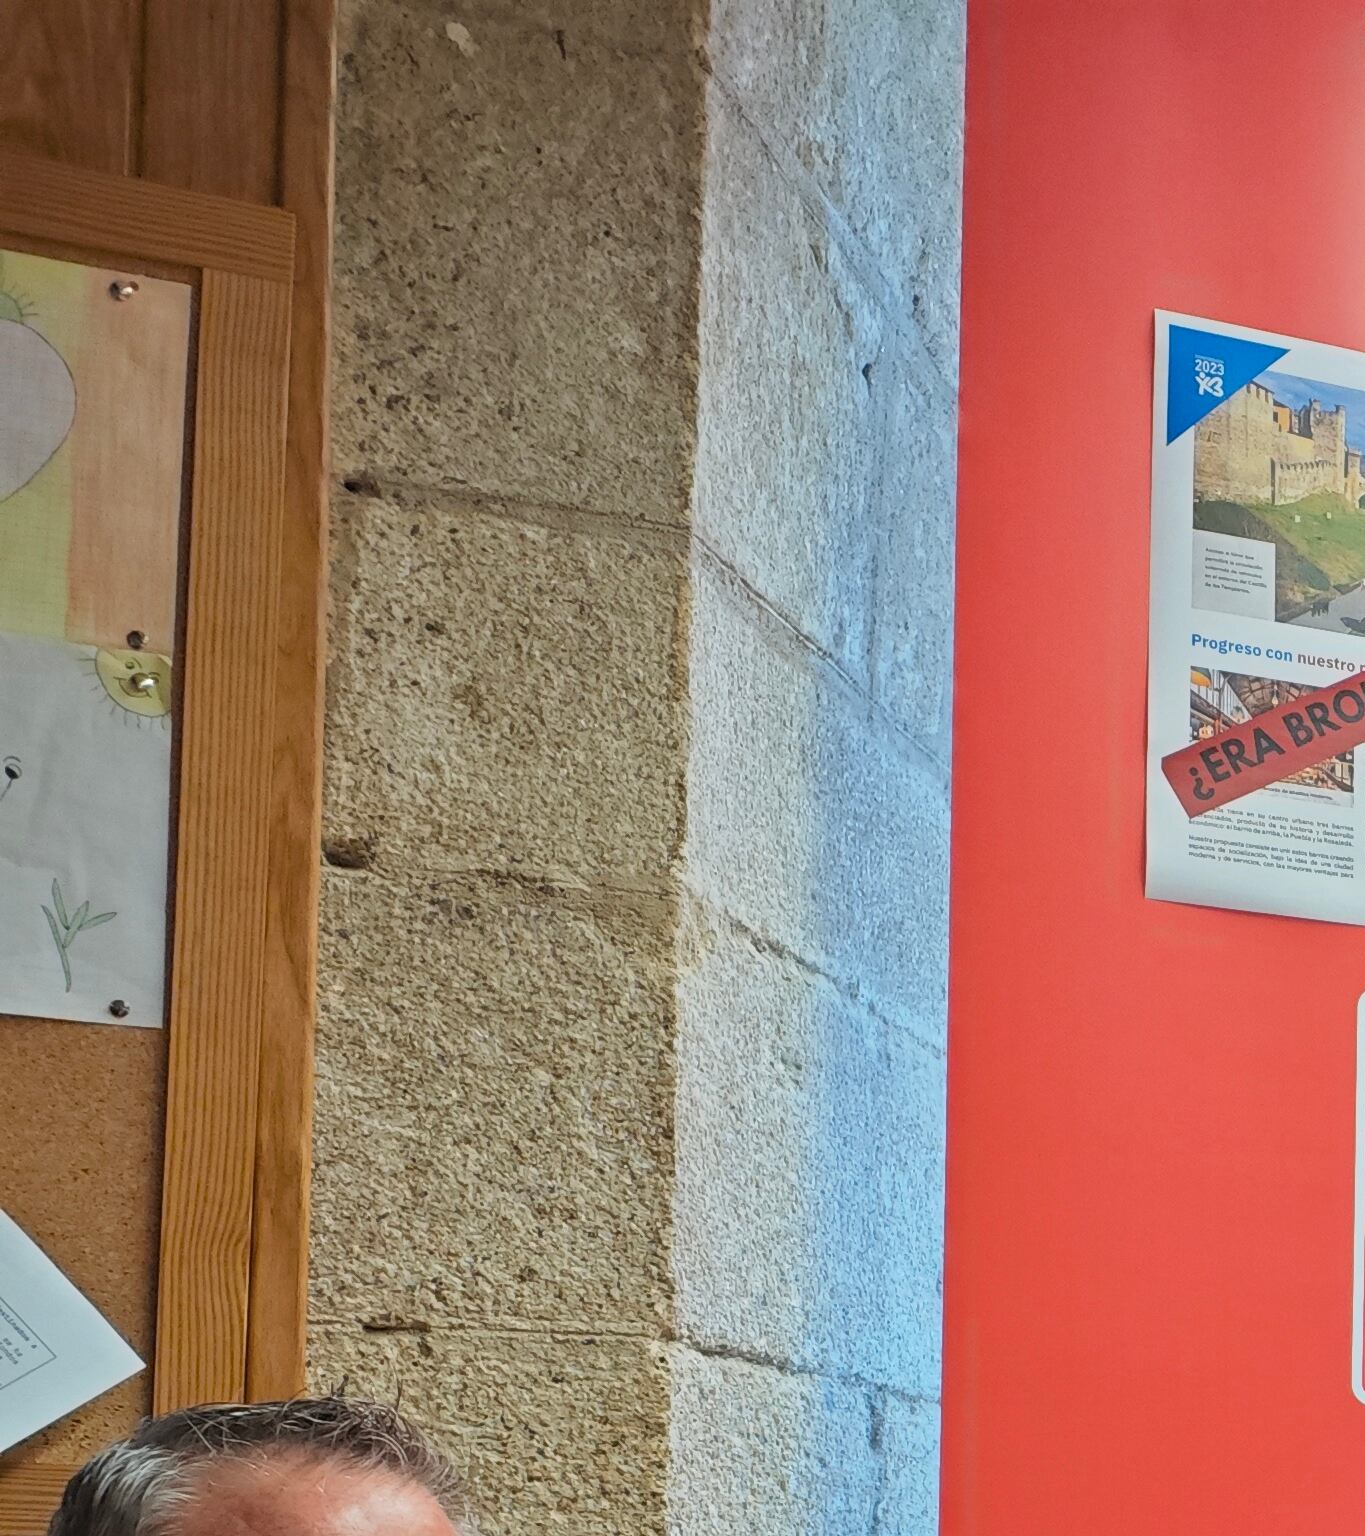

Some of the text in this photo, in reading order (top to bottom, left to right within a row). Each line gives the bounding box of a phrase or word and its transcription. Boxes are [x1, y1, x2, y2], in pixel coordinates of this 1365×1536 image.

[1195, 358, 1224, 375] 2023
[1191, 633, 1261, 657] Progreso
[1265, 648, 1293, 663] con
[1297, 652, 1355, 673] nuestro
[1189, 728, 1285, 801] ¿ERA
